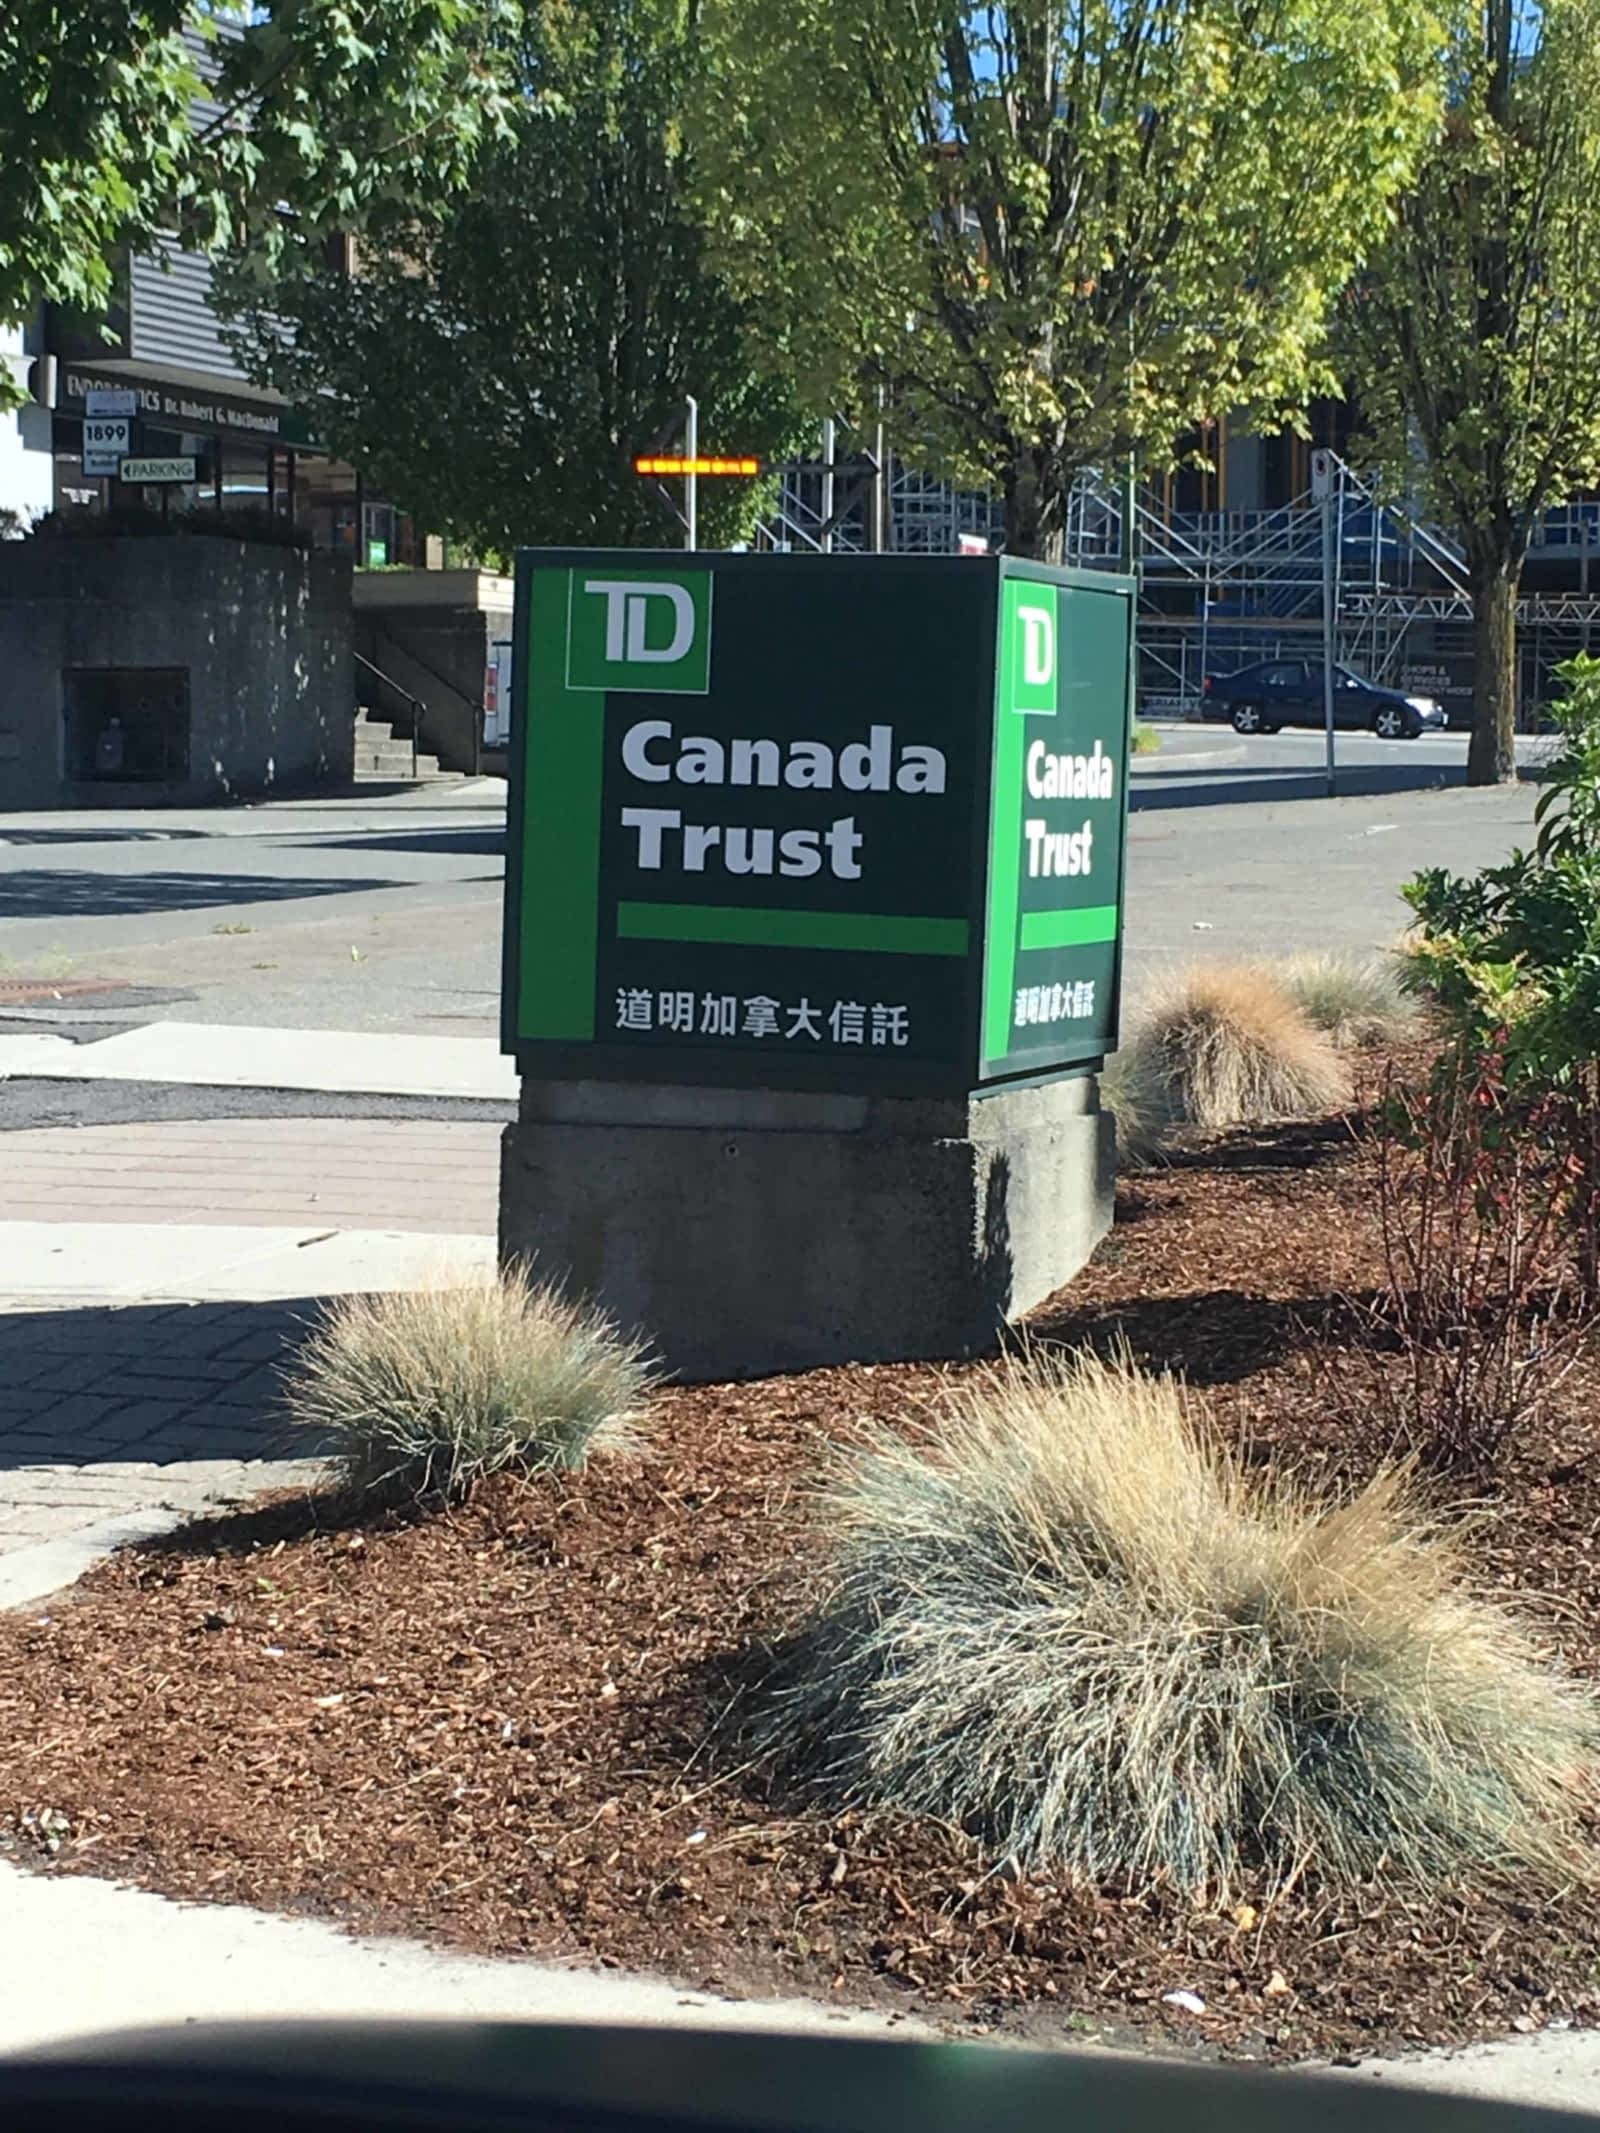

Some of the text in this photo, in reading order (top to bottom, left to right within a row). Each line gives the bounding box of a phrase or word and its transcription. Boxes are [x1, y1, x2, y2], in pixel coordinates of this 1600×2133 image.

[86, 425, 126, 441] 1899
[132, 462, 194, 478] PARKING
[584, 580, 696, 662] TD
[1018, 605, 1053, 686] TD
[622, 720, 947, 793] Canada
[1027, 739, 1113, 799] Canada
[621, 807, 863, 879] Trust
[1025, 819, 1092, 877] Trust
[615, 987, 909, 1046] 道明加拿大信託
